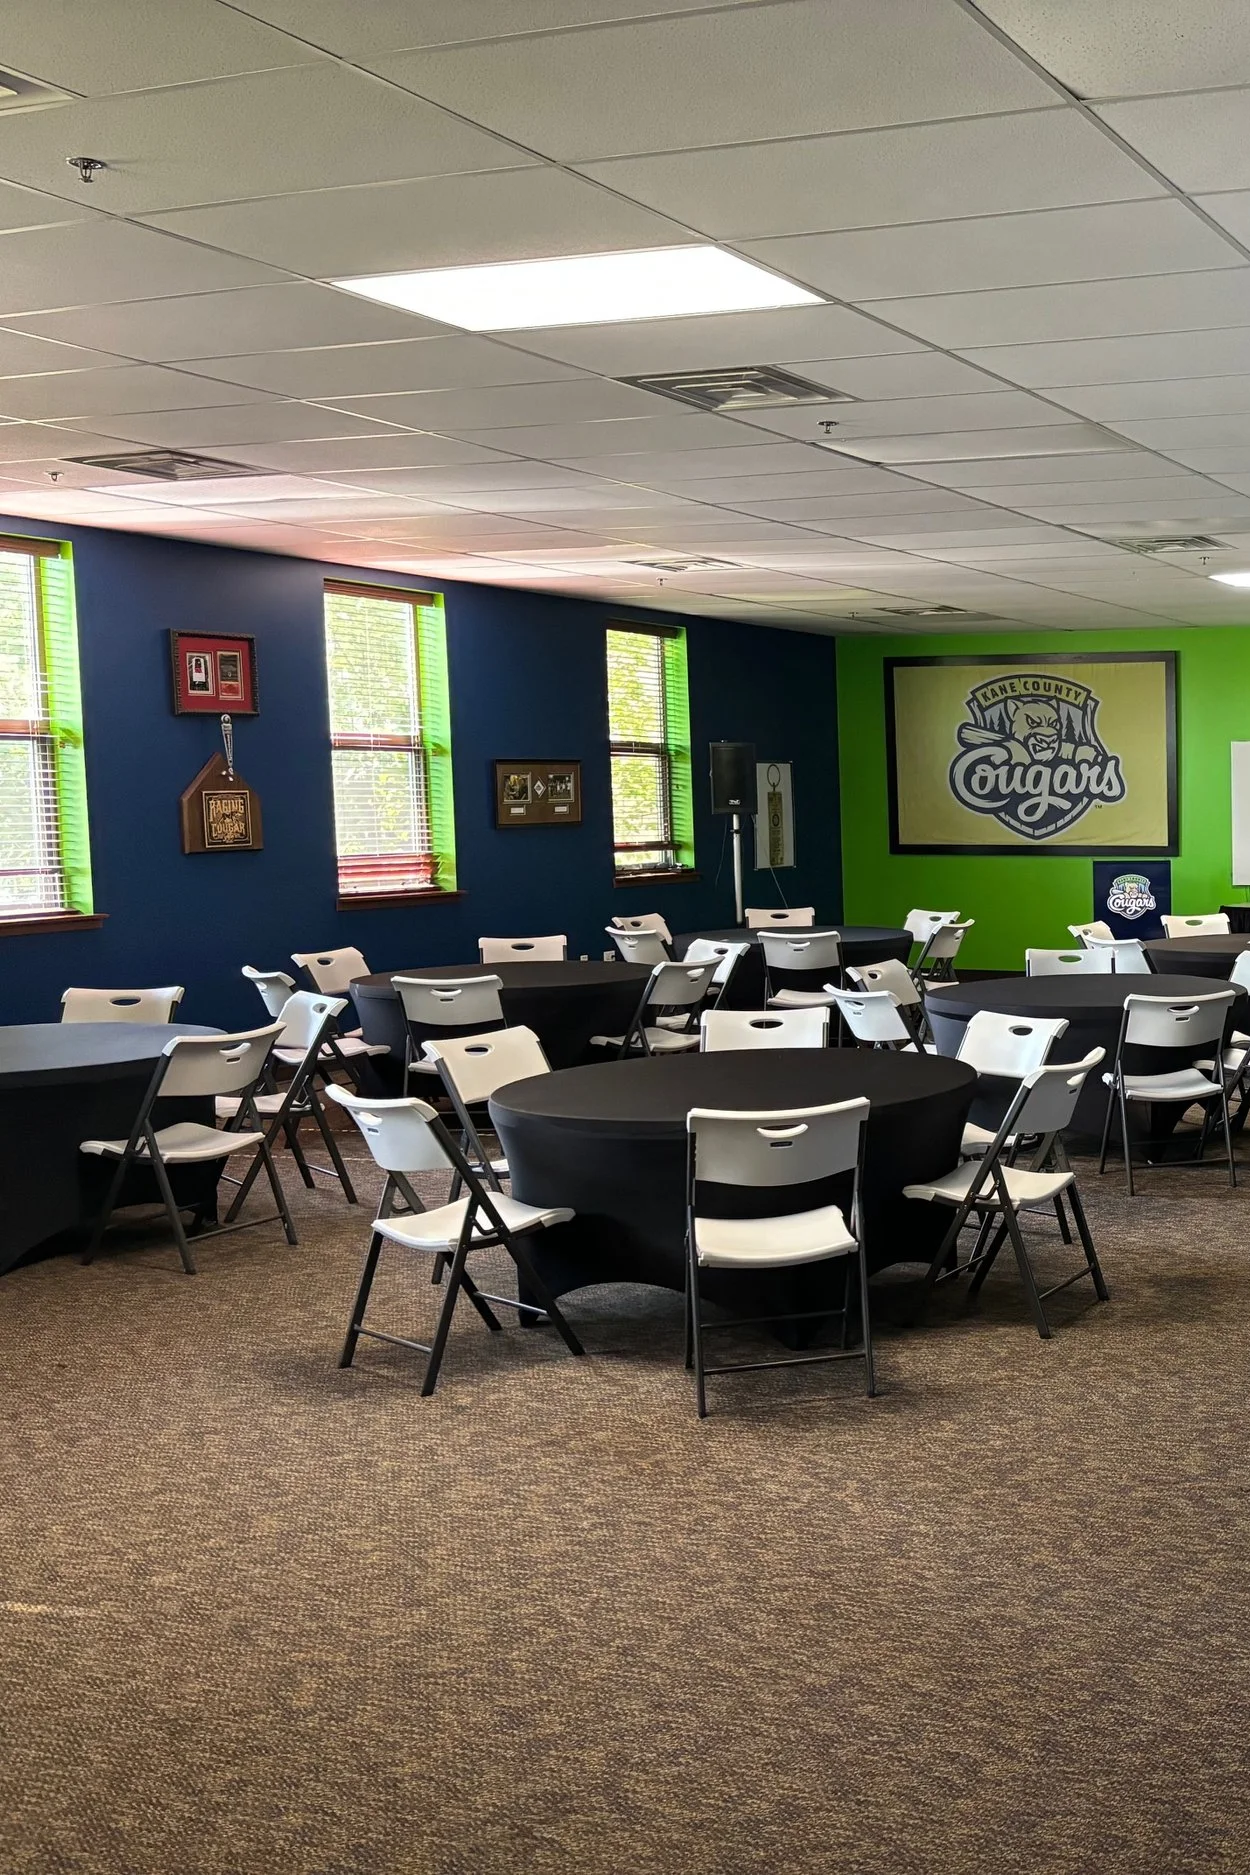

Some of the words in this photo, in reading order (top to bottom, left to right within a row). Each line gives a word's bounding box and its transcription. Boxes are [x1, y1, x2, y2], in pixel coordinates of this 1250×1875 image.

[980, 681, 1018, 703] KANE
[1022, 680, 1083, 702] COUNTY
[953, 746, 1122, 823] Cougars
[208, 799, 245, 822] RAGING
[210, 821, 246, 838] COUGAR
[1109, 894, 1154, 915] Cougars
